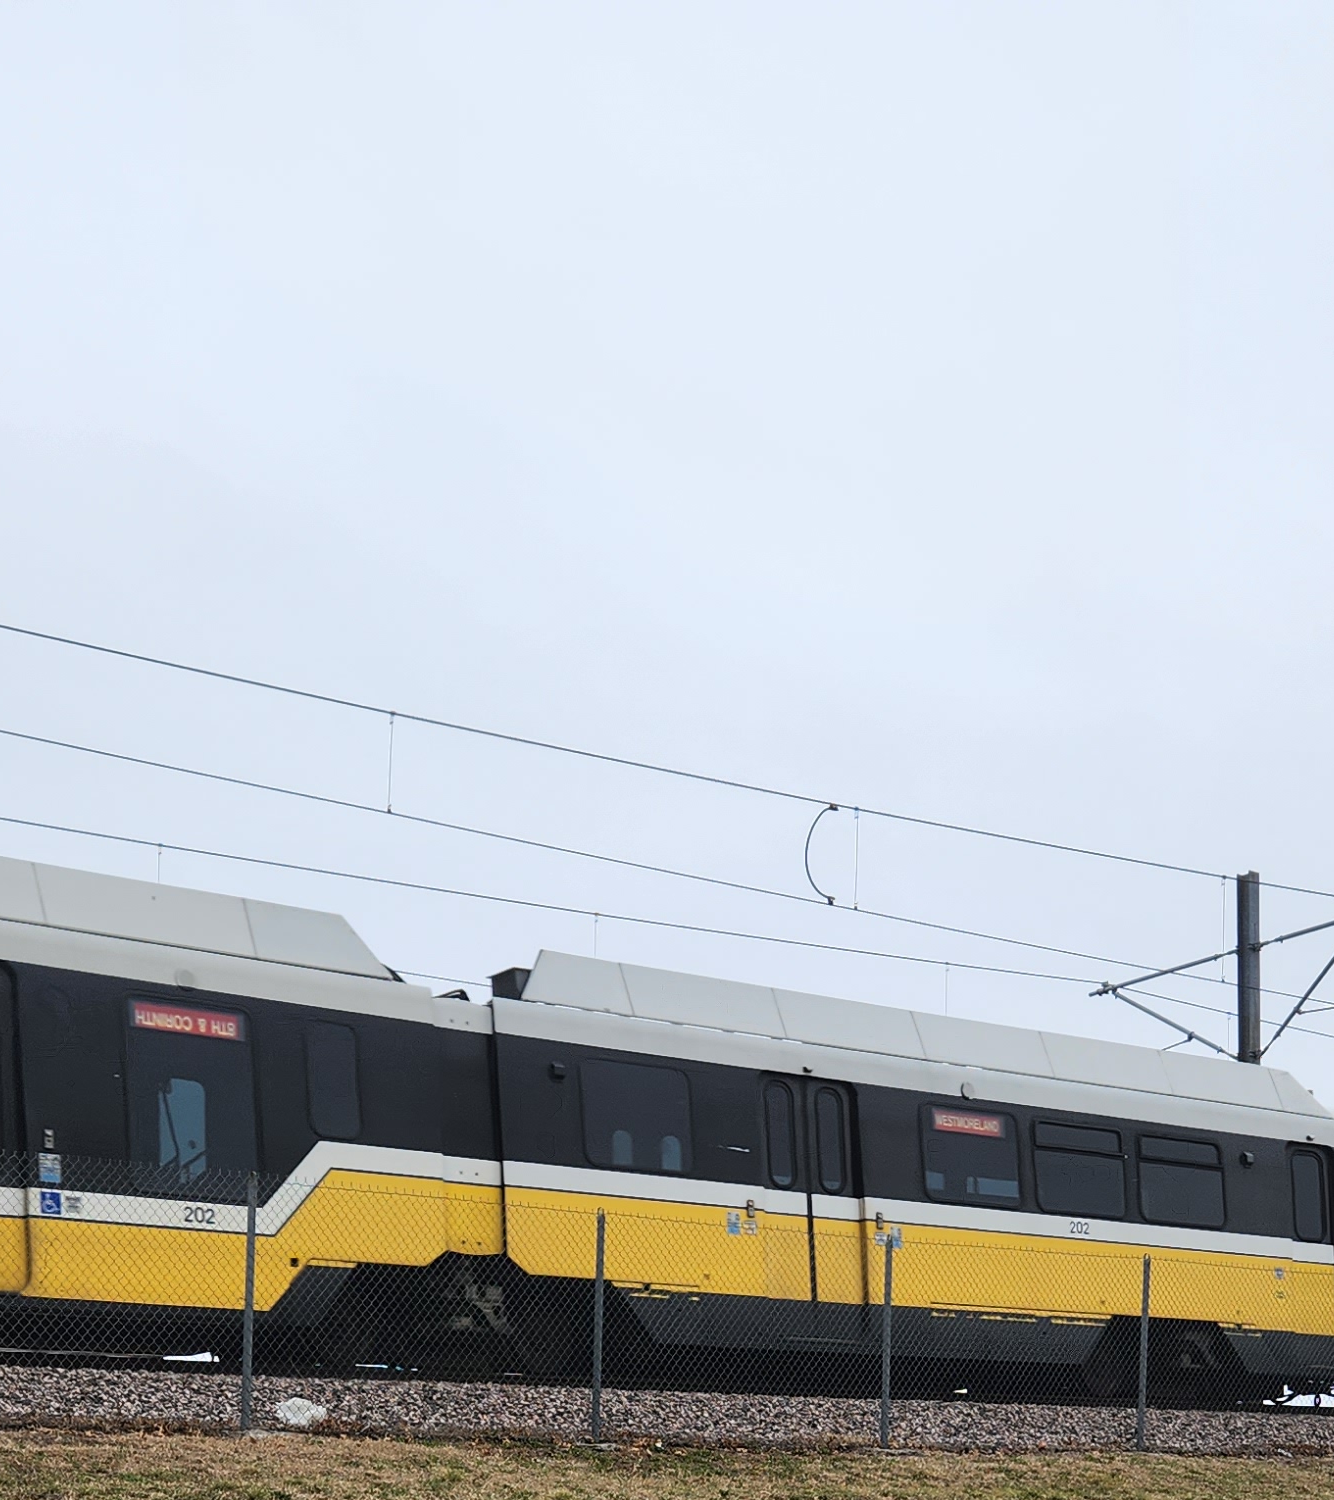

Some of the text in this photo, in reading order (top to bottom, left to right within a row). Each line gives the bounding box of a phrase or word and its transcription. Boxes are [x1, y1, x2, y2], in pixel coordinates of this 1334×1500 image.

[134, 1010, 193, 1031] CORINTH
[197, 1018, 207, 1032] &
[184, 1206, 216, 1224] 202
[1069, 1221, 1090, 1235] 202
